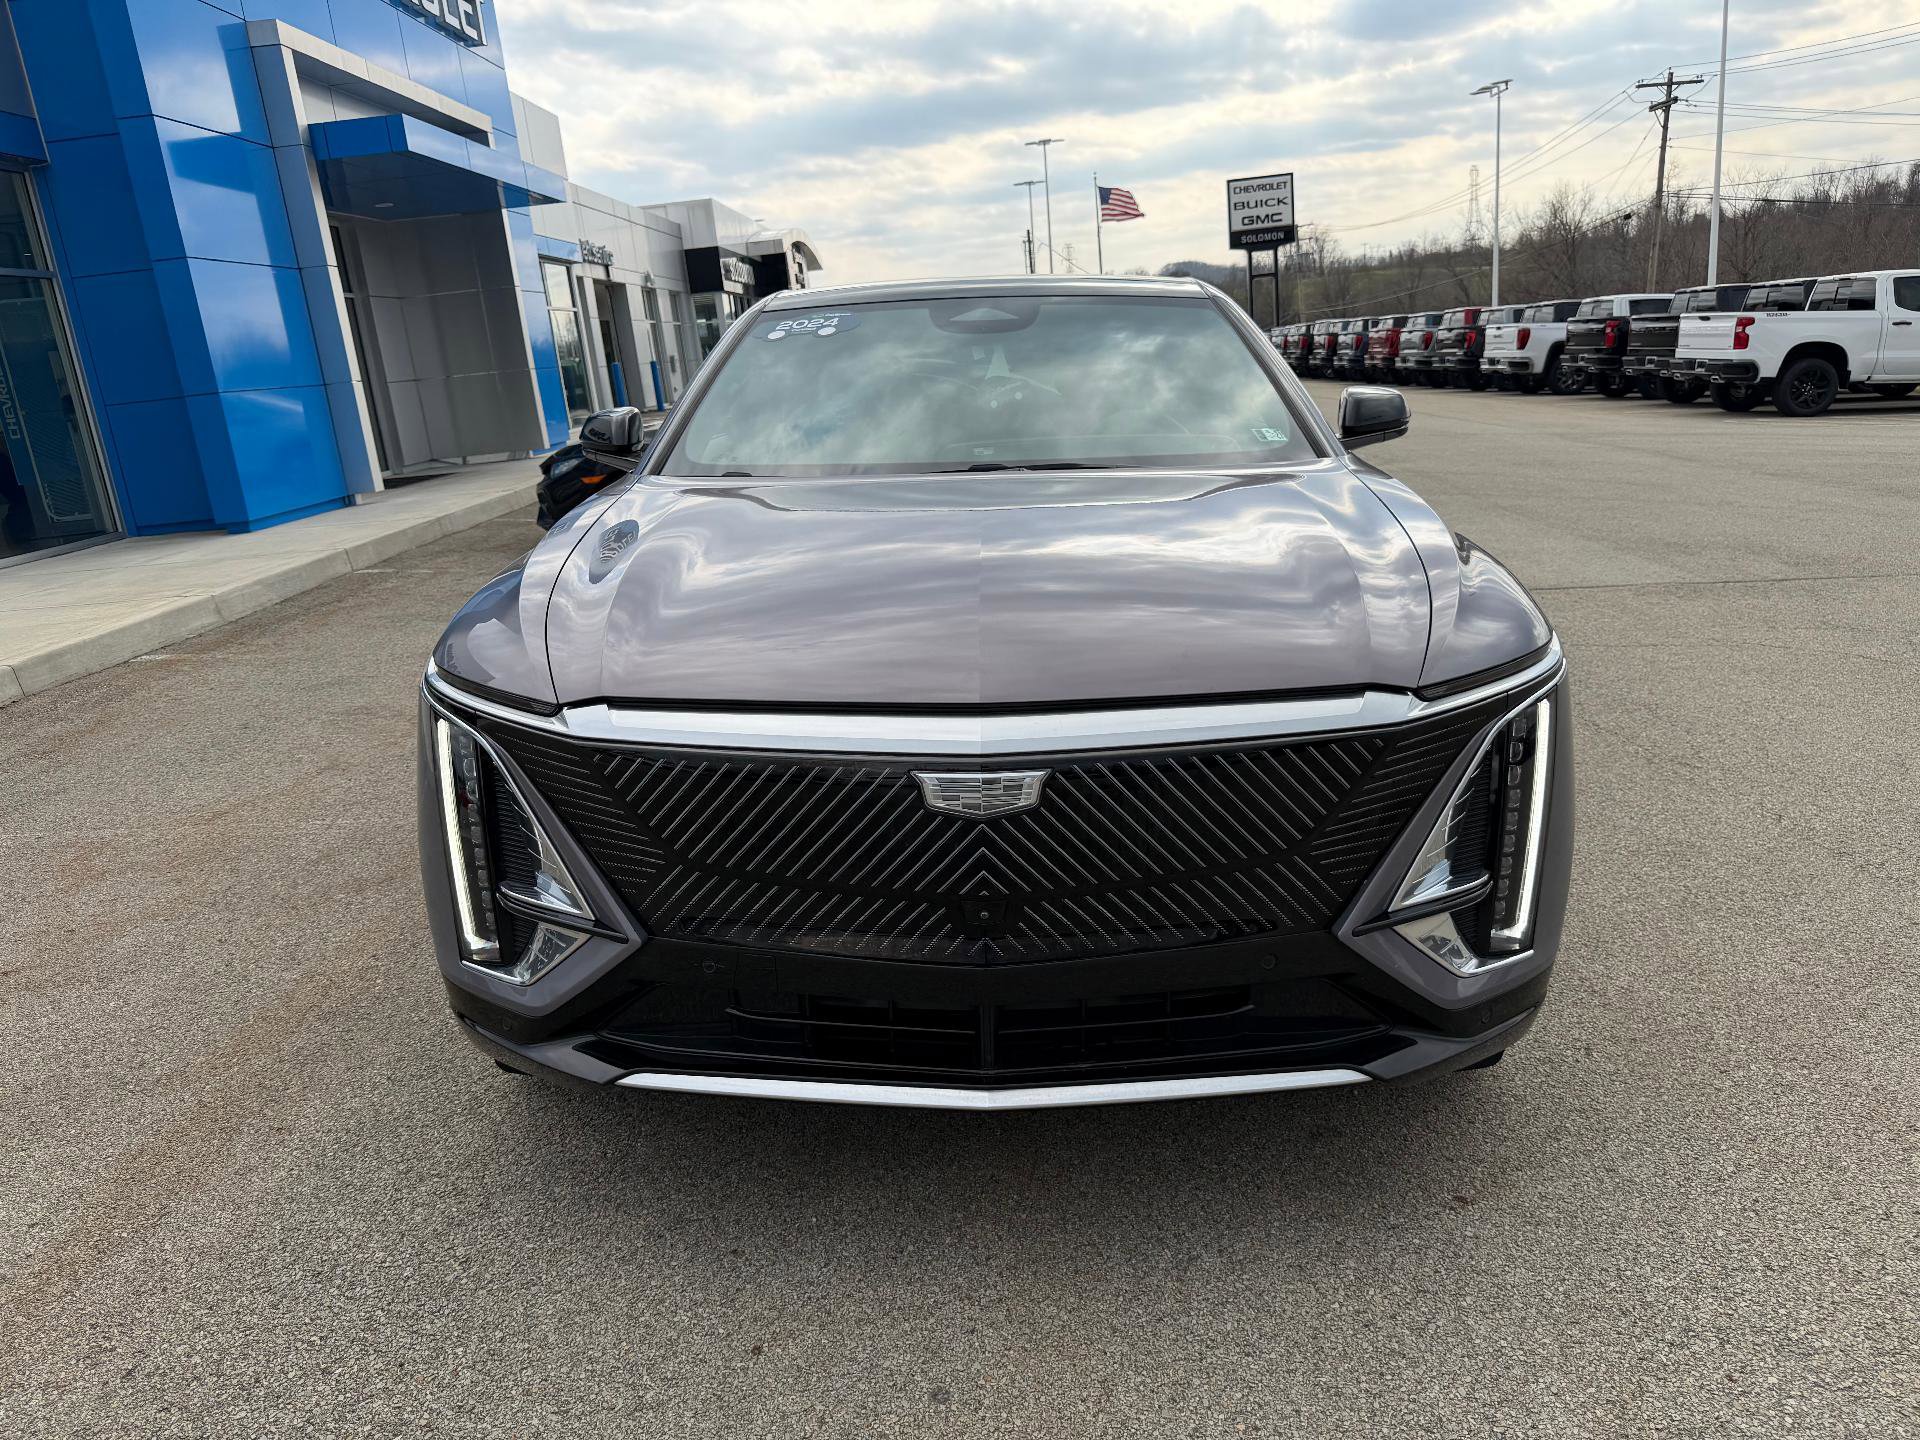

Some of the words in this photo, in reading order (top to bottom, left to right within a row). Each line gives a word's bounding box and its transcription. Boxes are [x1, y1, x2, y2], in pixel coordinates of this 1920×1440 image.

[1233, 181, 1288, 195] CHEVROLET
[1233, 196, 1289, 211] BUICK
[1241, 212, 1283, 226] GMC
[1240, 231, 1285, 244] SOLOMON
[775, 317, 839, 331] 2024
